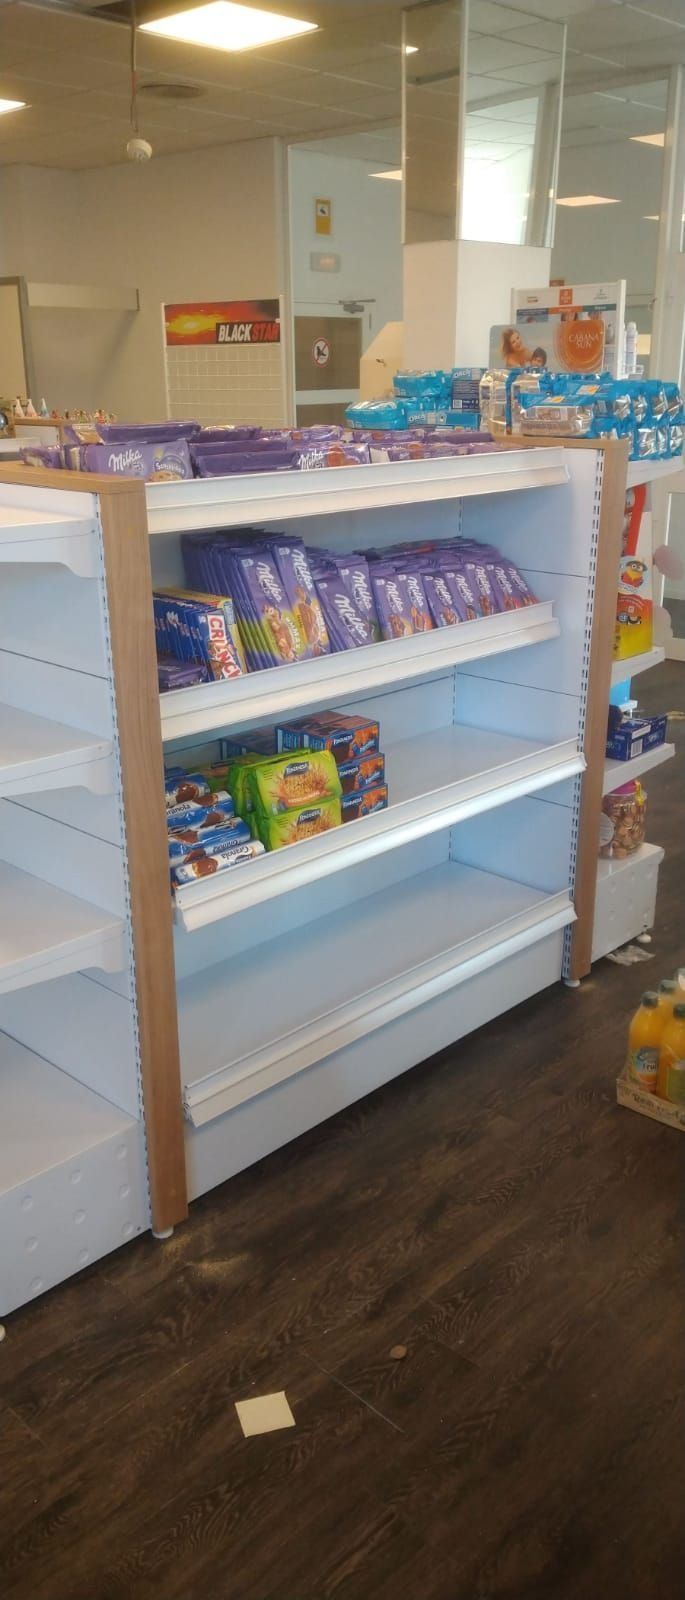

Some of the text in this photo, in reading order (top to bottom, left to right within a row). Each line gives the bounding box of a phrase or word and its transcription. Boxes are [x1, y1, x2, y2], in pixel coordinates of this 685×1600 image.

[218, 323, 252, 342] BLACK
[568, 333, 600, 343] CABANA
[108, 449, 142, 472] Milka
[256, 561, 282, 603] Milka
[291, 548, 313, 591] Milka
[352, 570, 372, 609] Milka
[385, 581, 403, 612] Milka
[407, 576, 424, 606] Milka
[456, 574, 474, 605] Milka
[334, 593, 367, 640] Milka
[166, 803, 191, 816] ranola
[220, 846, 249, 859] Granola
